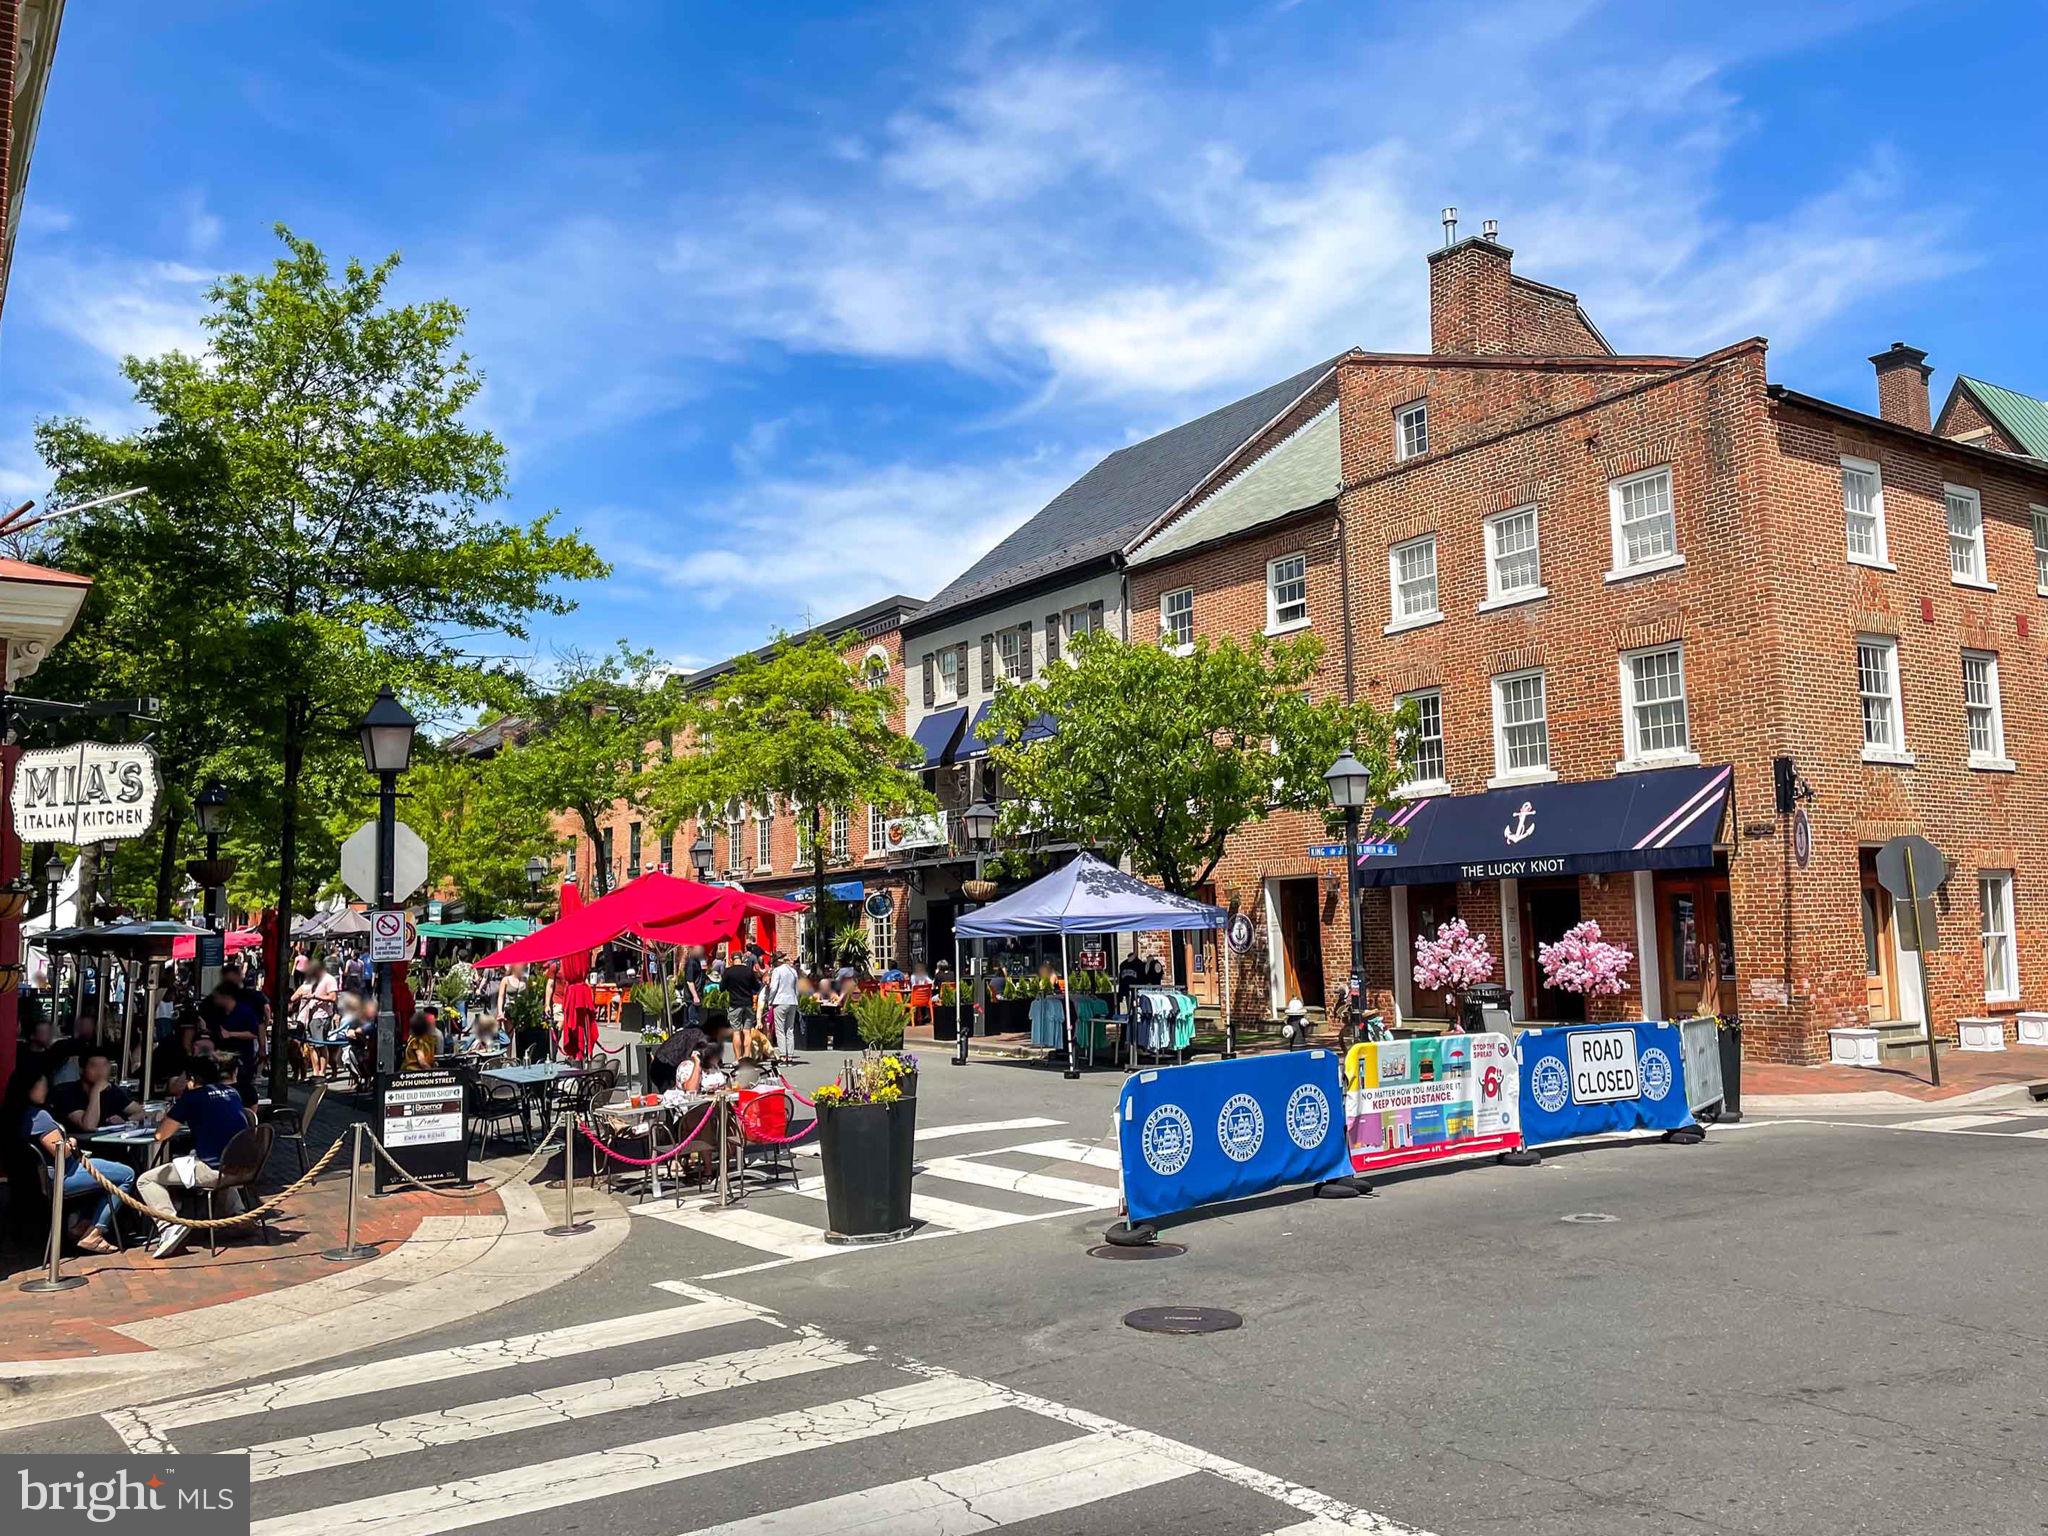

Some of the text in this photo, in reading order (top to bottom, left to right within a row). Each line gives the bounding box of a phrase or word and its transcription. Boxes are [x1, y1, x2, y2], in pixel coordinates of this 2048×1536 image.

[24, 761, 144, 808] MIA'S
[24, 809, 143, 829] ITALIAN KITCHEN
[1310, 848, 1325, 856] KING
[1460, 859, 1565, 878] THE LUCKY KNOT
[1582, 1039, 1623, 1062] ROAD
[1578, 1069, 1634, 1094] CLOSED
[437, 1089, 454, 1097] SHOP
[1362, 1092, 1373, 1100] NO
[1374, 1089, 1396, 1098] MATTER
[1397, 1088, 1411, 1096] HOW
[1412, 1086, 1424, 1094] YOU
[1426, 1083, 1453, 1092] MEASURE
[1372, 1091, 1454, 1110] KEEP YOUR DISTANCE.
